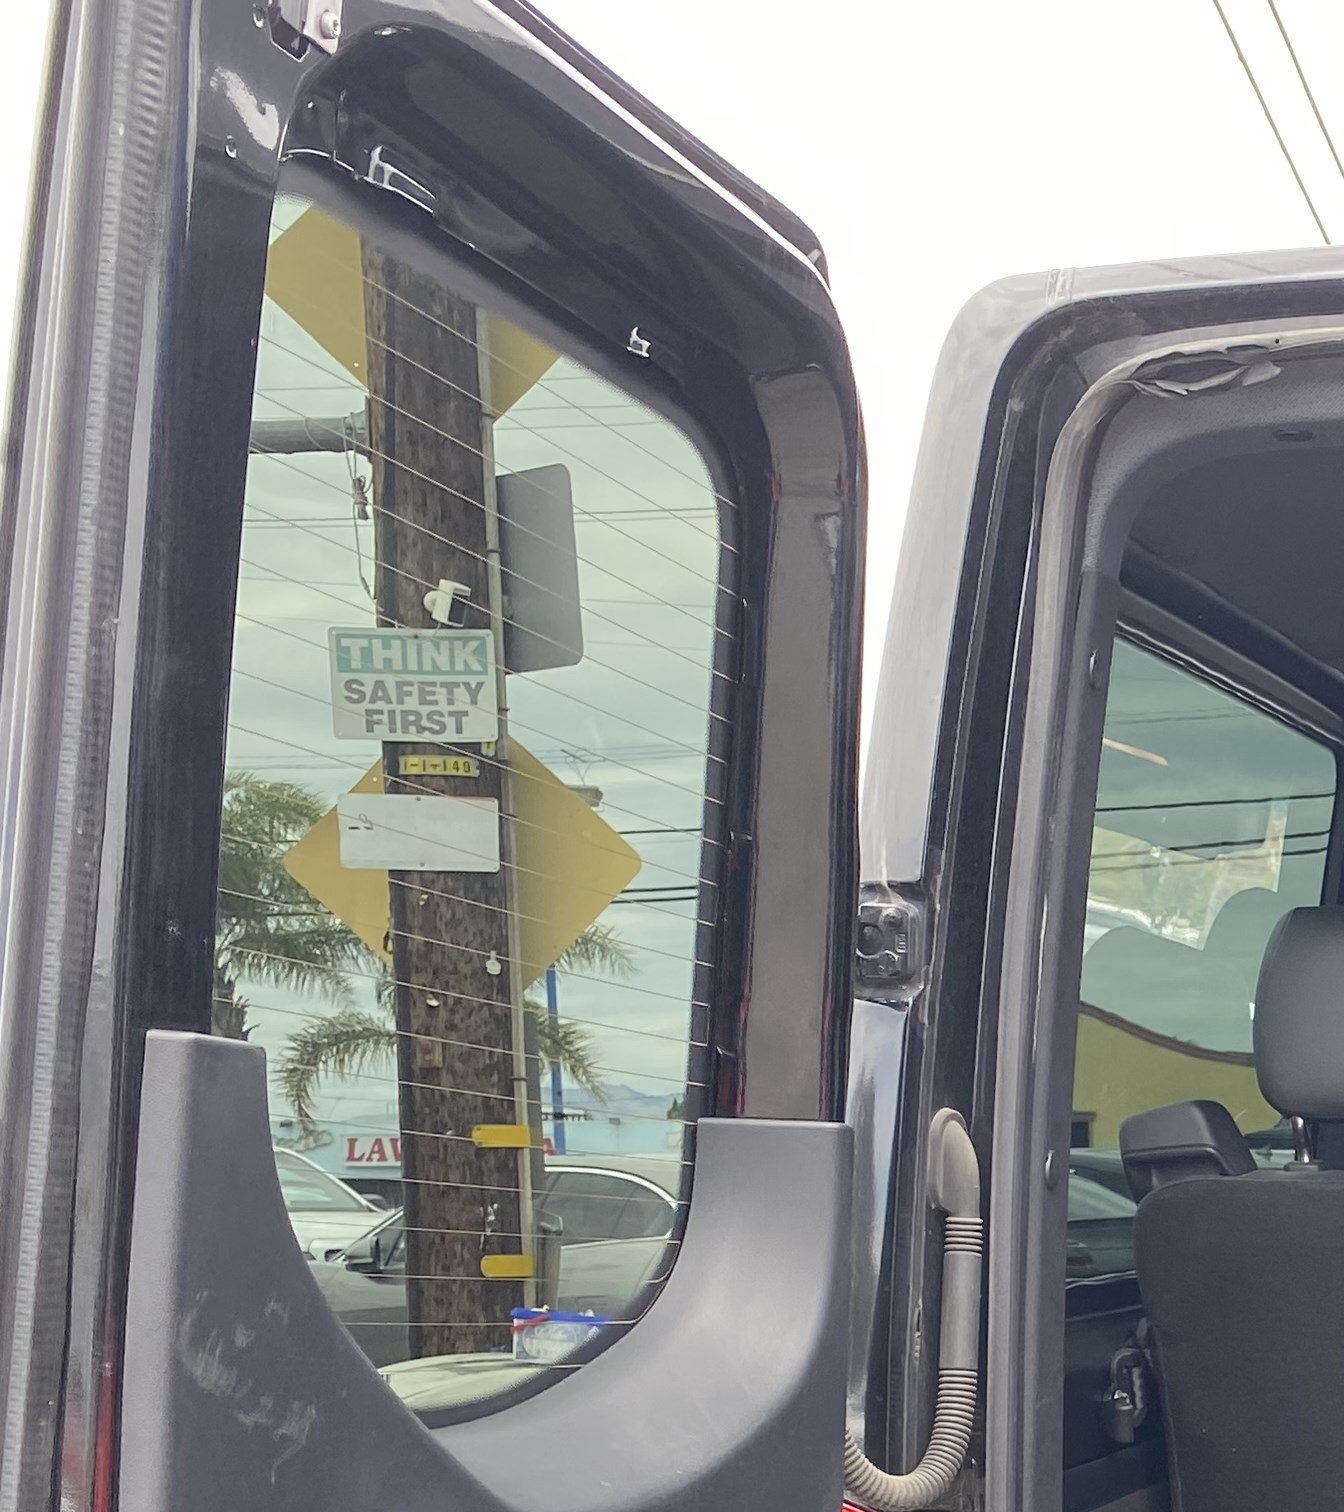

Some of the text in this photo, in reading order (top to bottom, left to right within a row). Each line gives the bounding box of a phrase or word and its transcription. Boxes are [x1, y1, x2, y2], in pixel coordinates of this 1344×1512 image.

[340, 637, 483, 672] THINK
[343, 678, 486, 706] SAFETY
[364, 708, 469, 736] FIRST
